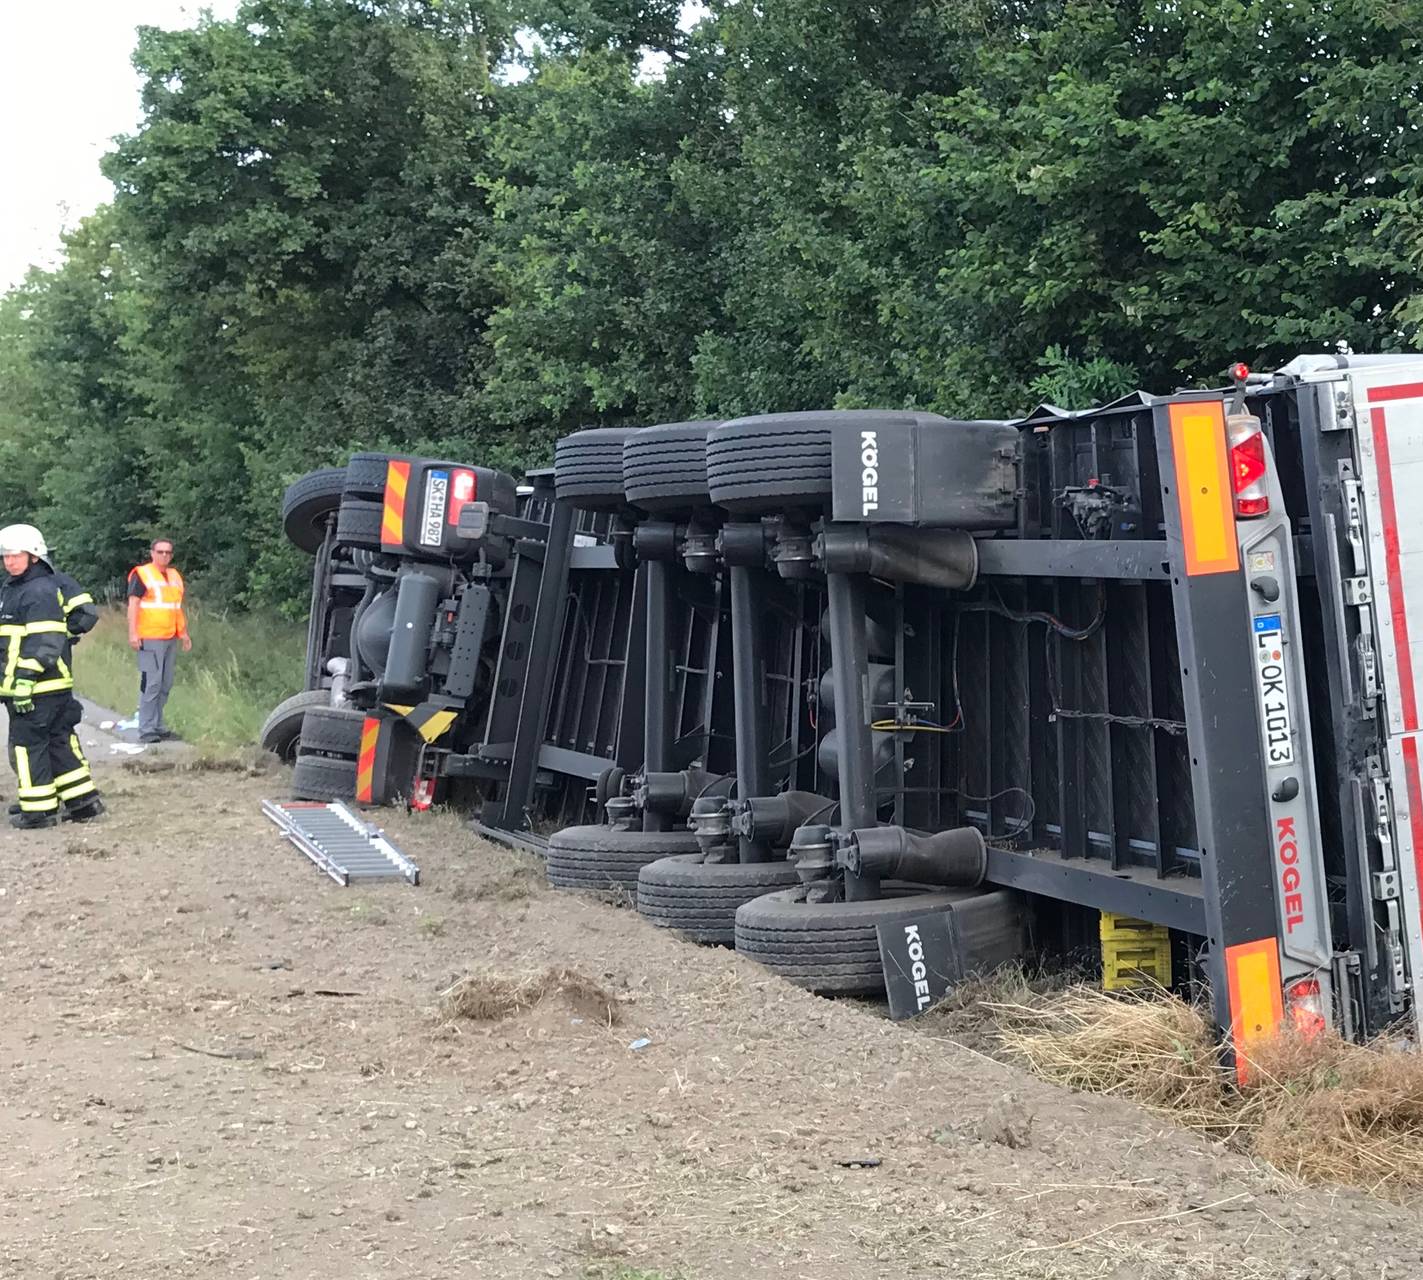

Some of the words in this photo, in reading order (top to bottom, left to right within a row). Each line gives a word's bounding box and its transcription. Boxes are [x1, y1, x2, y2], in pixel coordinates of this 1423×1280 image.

[431, 480, 446, 496] SK
[861, 431, 879, 517] KÖGEL
[429, 503, 443, 518] HA
[427, 521, 441, 544] 987
[1258, 631, 1279, 648] L
[1261, 665, 1284, 697] OK
[1265, 702, 1291, 762] 1013
[1276, 817, 1304, 934] KÖGEL
[904, 924, 931, 1011] KÖGEL
